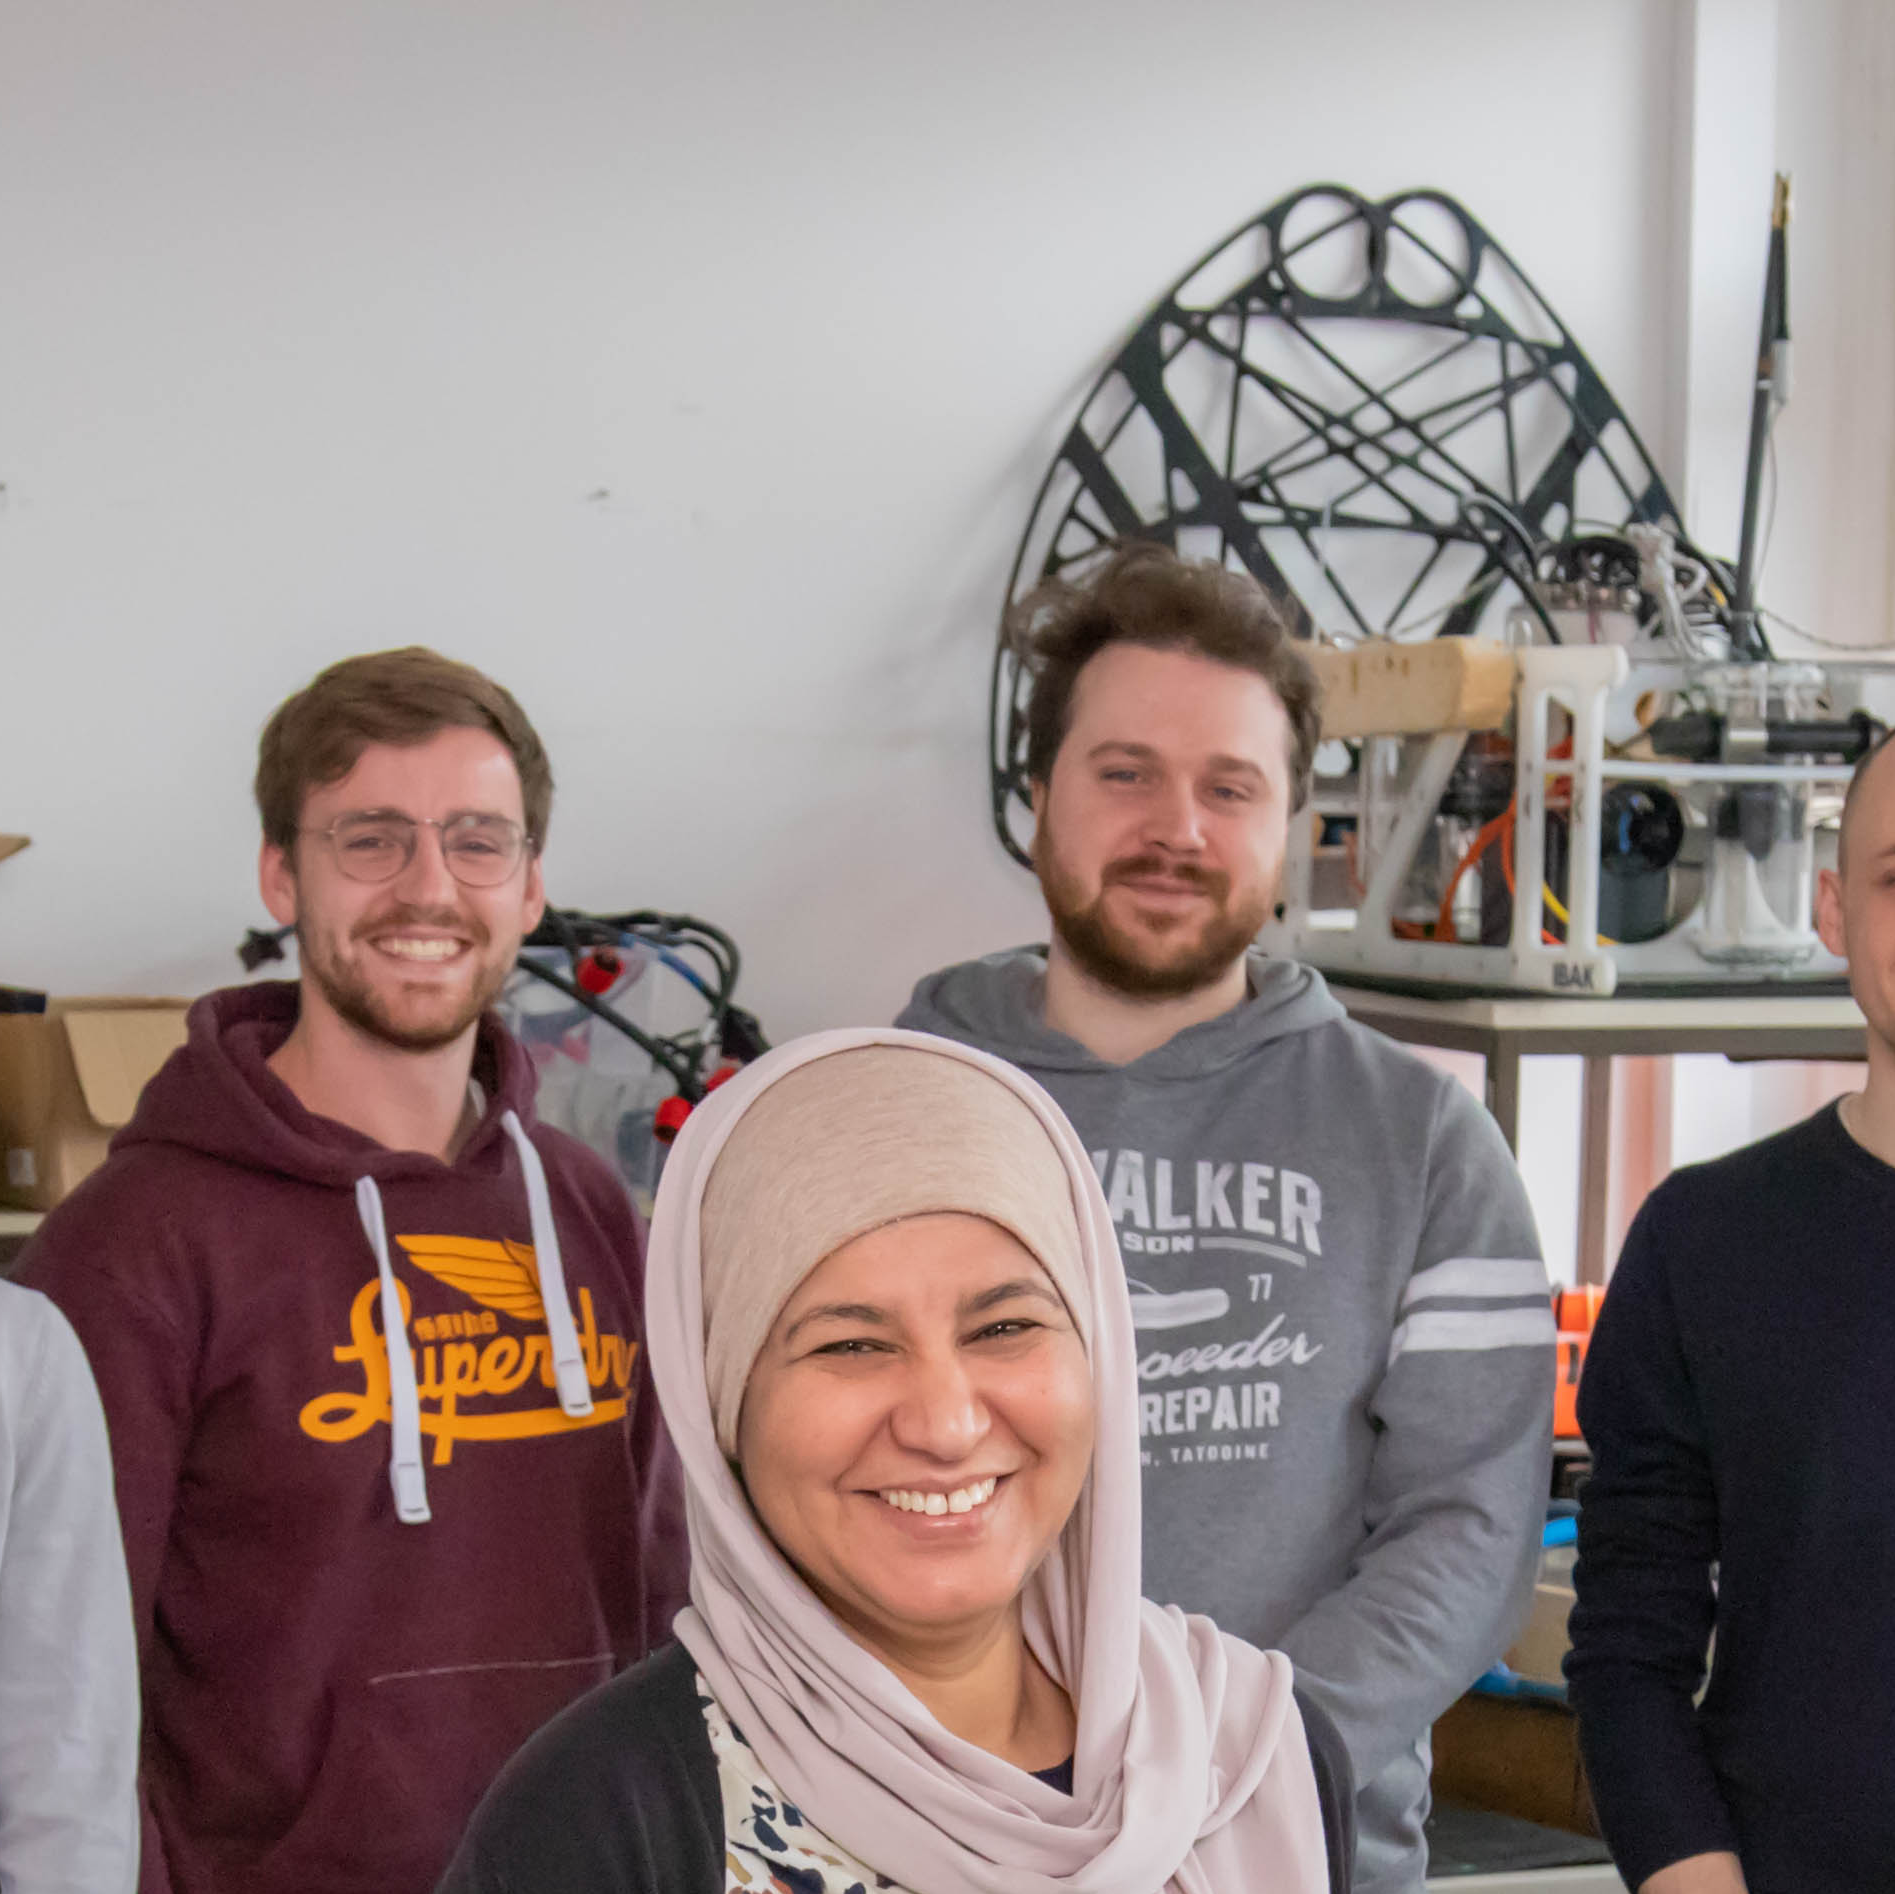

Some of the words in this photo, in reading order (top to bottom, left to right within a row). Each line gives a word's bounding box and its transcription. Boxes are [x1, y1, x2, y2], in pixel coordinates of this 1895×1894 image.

[1090, 1149, 1322, 1256] ALKER
[1122, 1232, 1194, 1255] SON
[1248, 1273, 1272, 1302] 77
[1139, 1381, 1280, 1437] REPAIR
